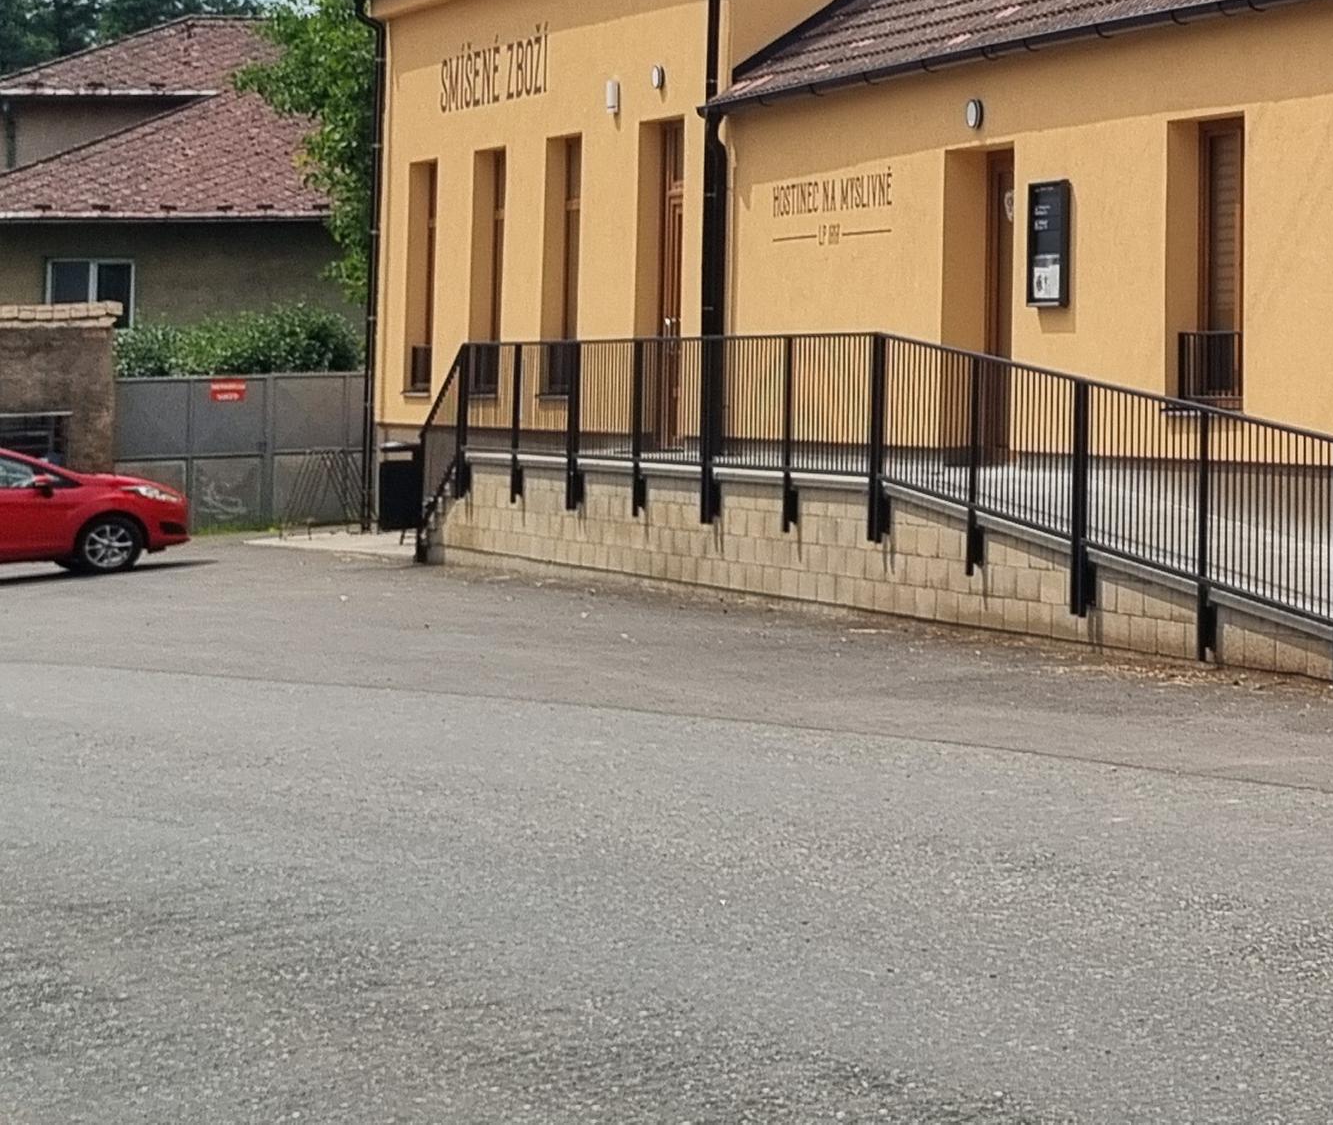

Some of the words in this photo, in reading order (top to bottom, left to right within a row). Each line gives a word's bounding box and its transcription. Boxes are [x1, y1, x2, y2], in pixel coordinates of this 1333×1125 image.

[440, 33, 500, 113] SMÍŠENÉ
[506, 21, 549, 100] ZBOŽÍ
[773, 181, 819, 218] HOSTINEC
[823, 179, 837, 212] NA
